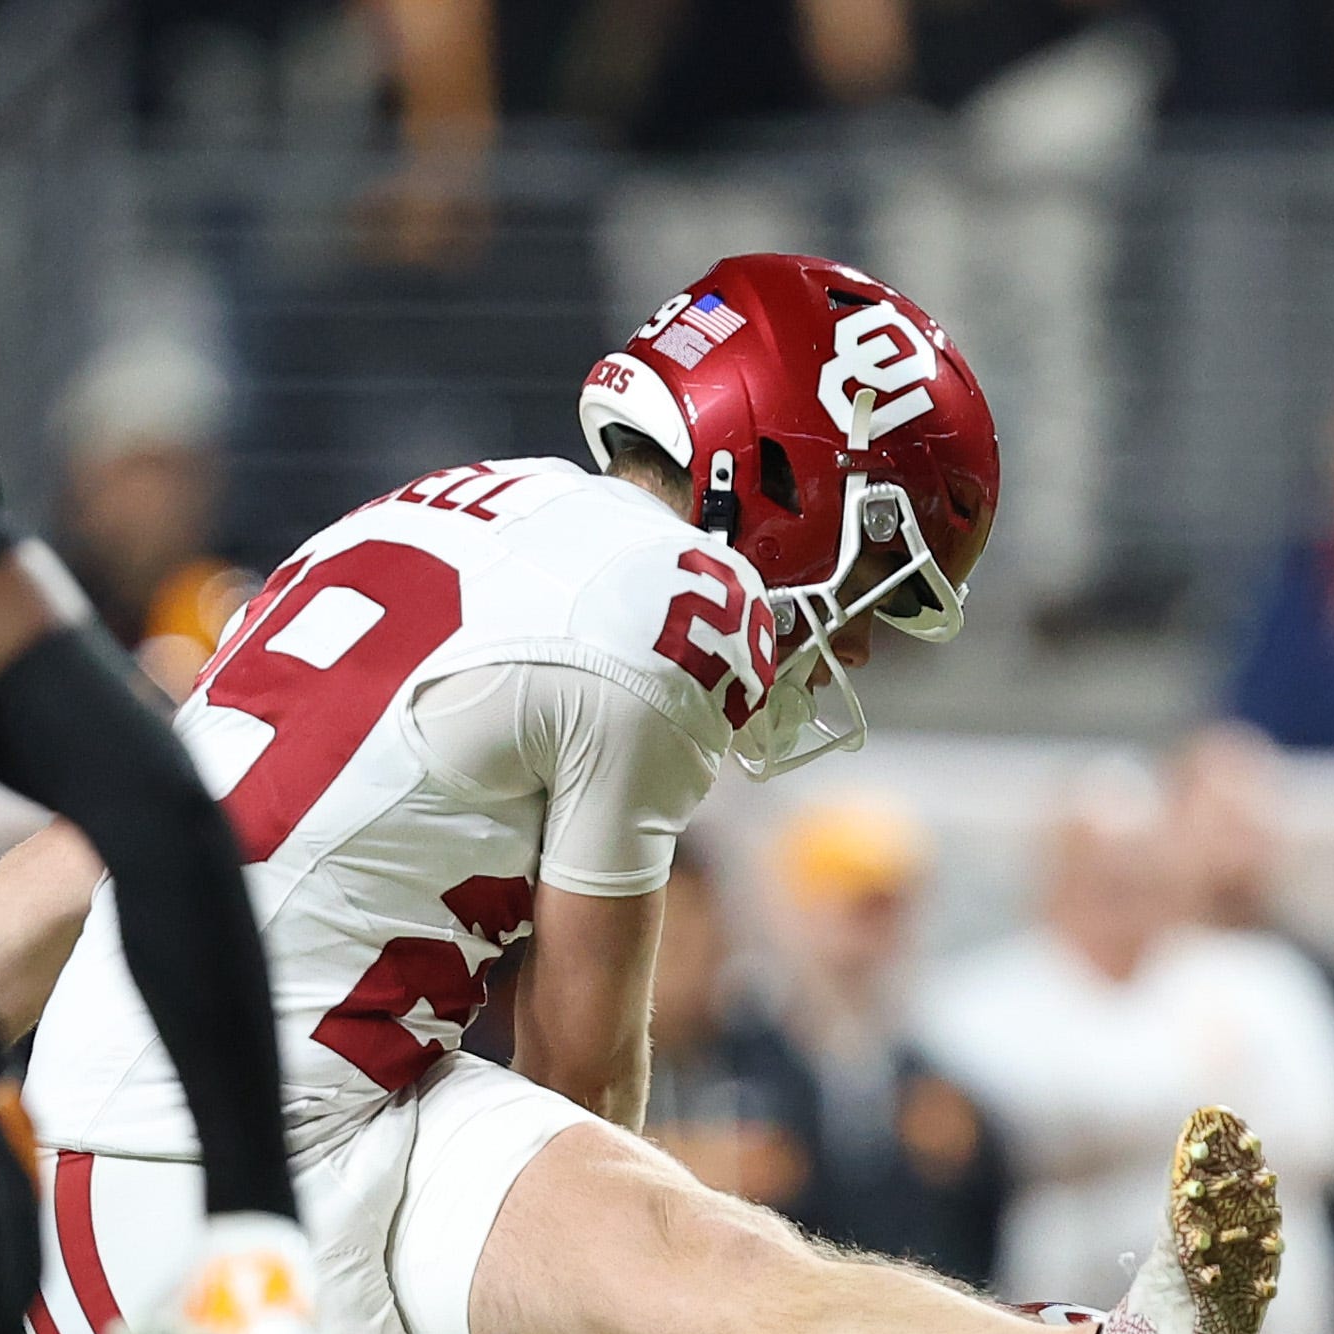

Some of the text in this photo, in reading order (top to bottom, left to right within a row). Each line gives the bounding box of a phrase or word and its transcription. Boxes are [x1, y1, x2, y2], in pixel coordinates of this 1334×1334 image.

[627, 292, 693, 341] 9
[347, 462, 543, 522] ELL
[653, 548, 778, 731] 29
[194, 540, 464, 866] 9
